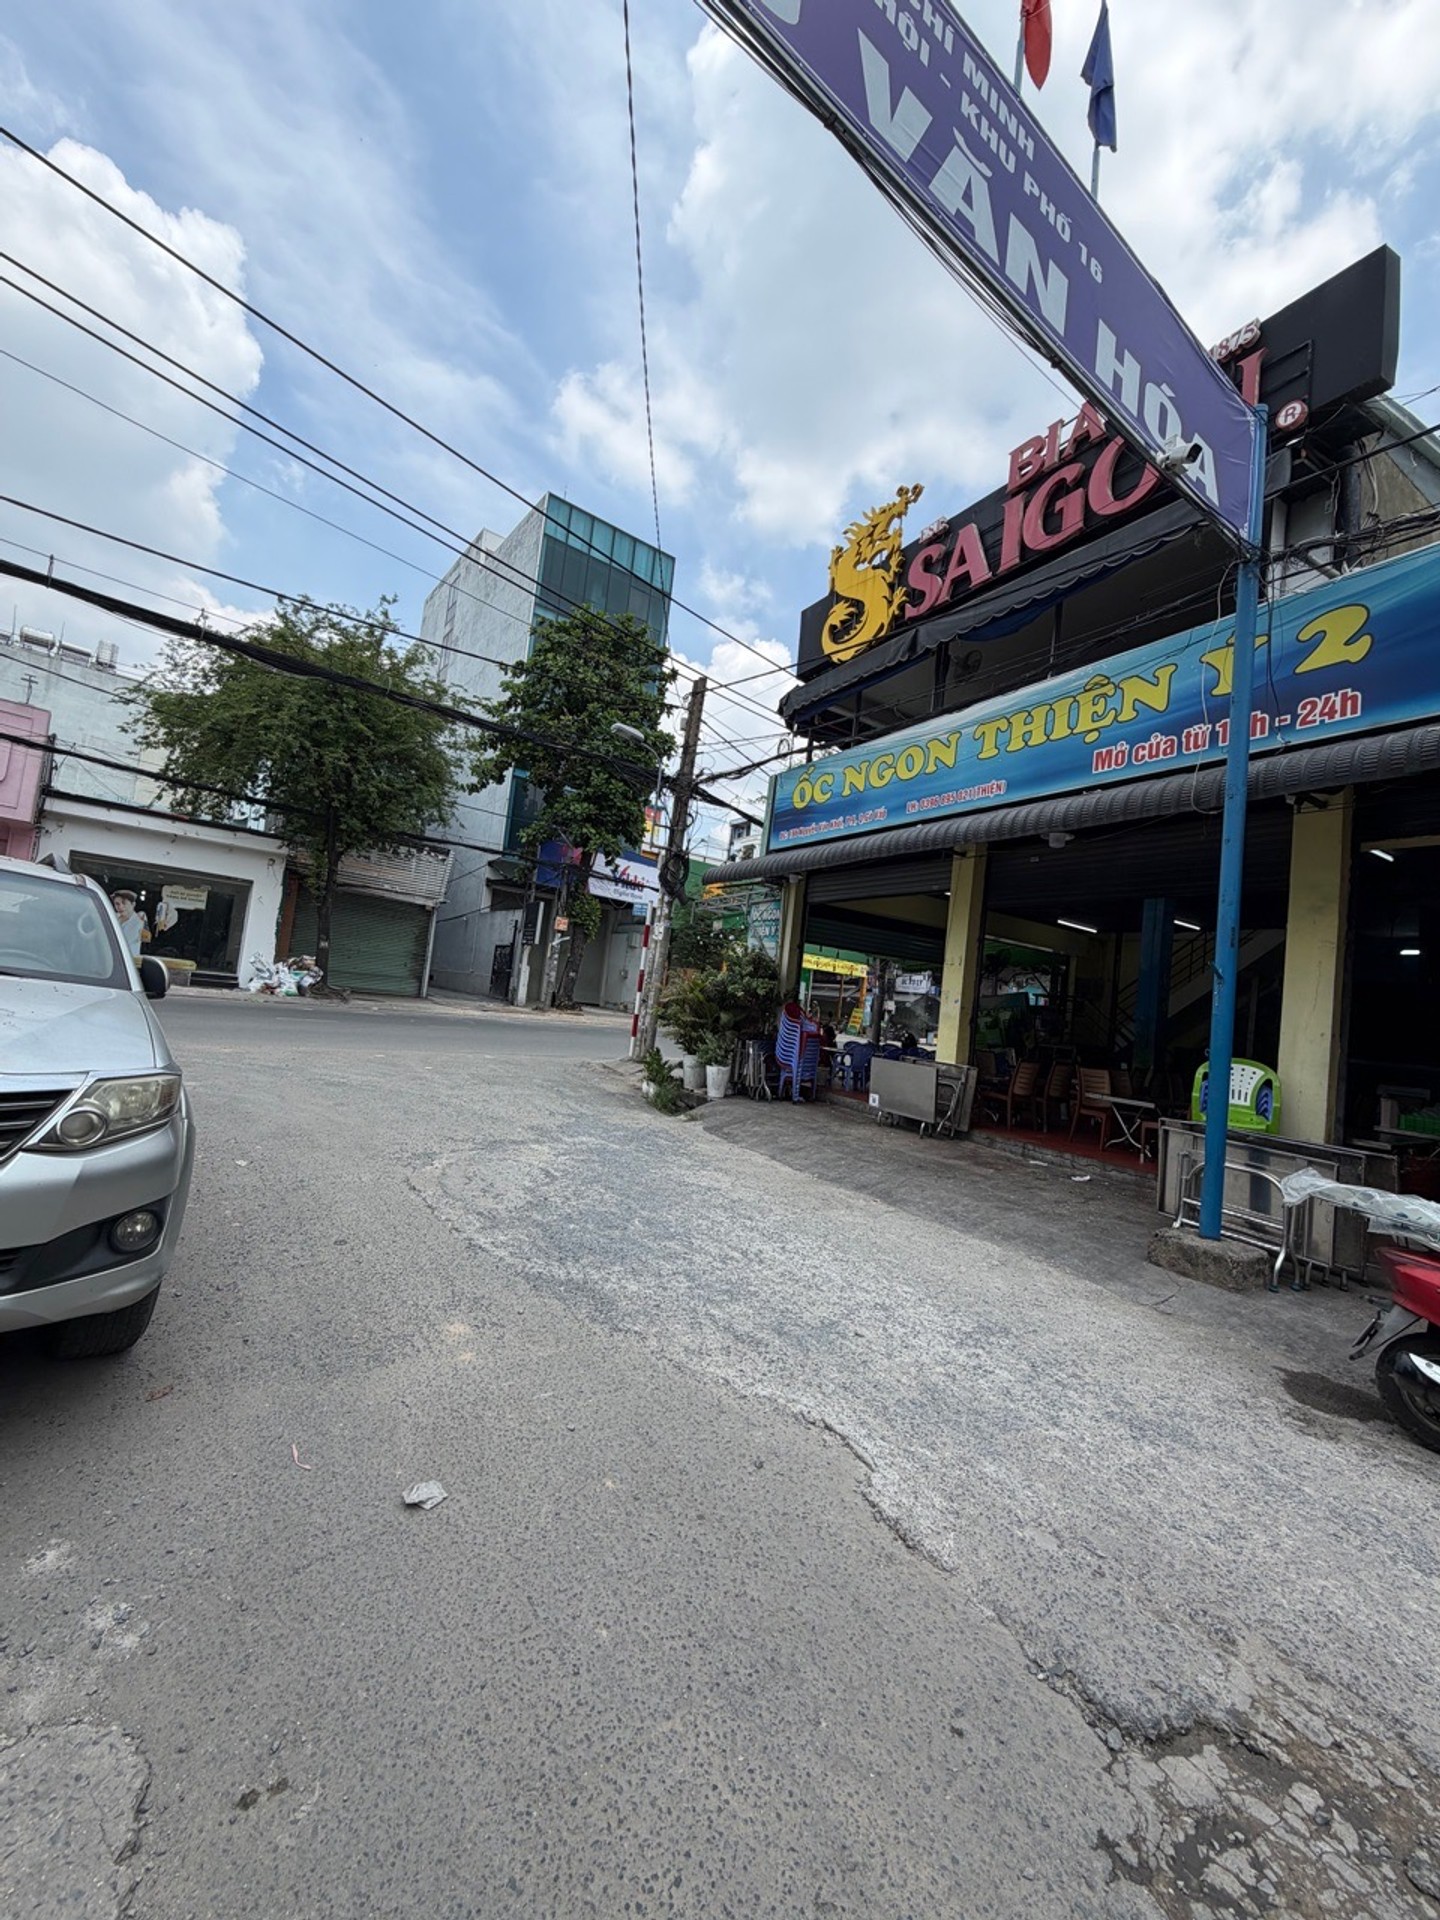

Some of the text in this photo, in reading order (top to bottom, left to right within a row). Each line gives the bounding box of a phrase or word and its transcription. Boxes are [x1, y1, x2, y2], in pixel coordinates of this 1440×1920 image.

[939, 72, 951, 89] -
[960, 90, 1017, 174] KHU
[1022, 170, 1073, 244] PHỐ
[1078, 240, 1103, 284] 16
[963, 51, 1035, 162] MINH
[857, 27, 1220, 507] VĂN HÓA
[1006, 400, 1108, 493] BIA
[792, 765, 833, 810] ỐC
[841, 730, 962, 798] NGON
[974, 663, 1178, 760] THIỆN
[1293, 603, 1374, 676] 2
[1092, 739, 1128, 773] Mở
[1132, 730, 1178, 765] cửa
[1182, 721, 1210, 754] từ
[1215, 710, 1269, 747] 1h
[1295, 688, 1362, 731] 24h
